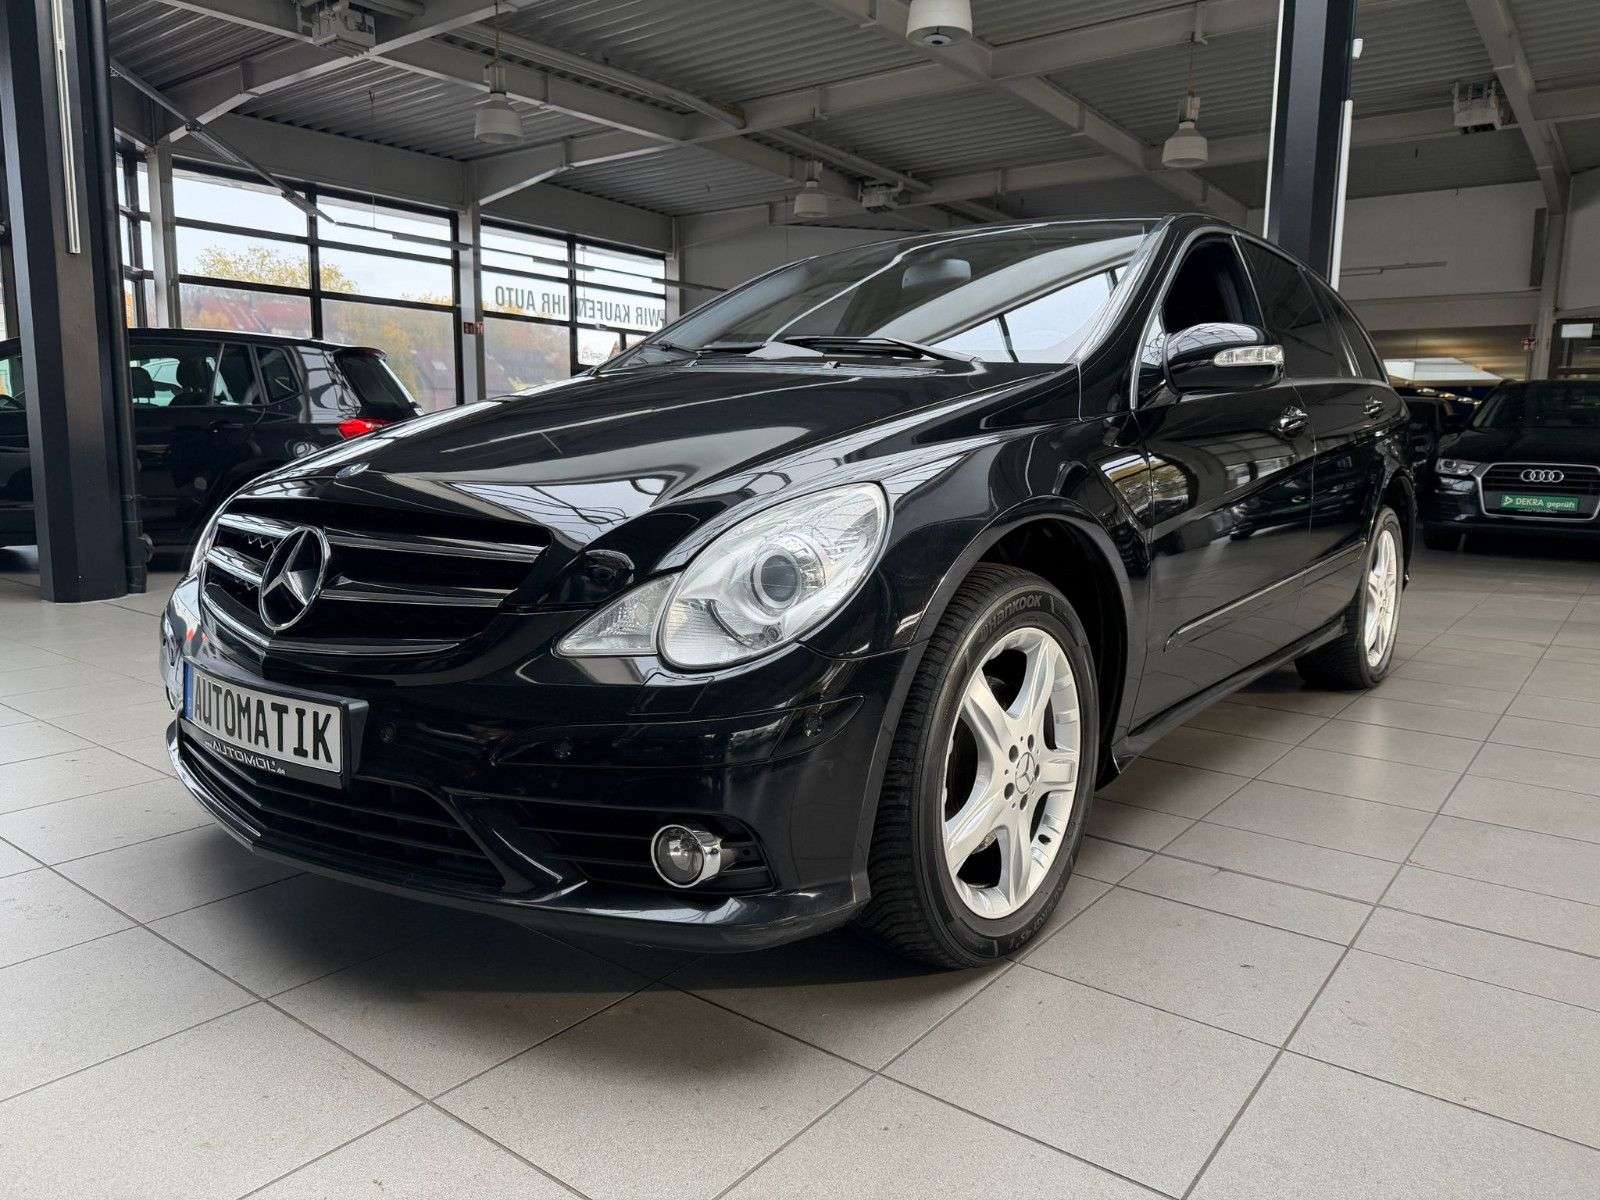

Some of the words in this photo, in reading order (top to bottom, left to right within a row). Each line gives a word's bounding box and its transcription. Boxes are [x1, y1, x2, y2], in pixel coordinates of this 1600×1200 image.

[1516, 498, 1544, 507] DEKRA
[1547, 501, 1576, 510] geprüft
[195, 676, 332, 763] AUTOMATIK
